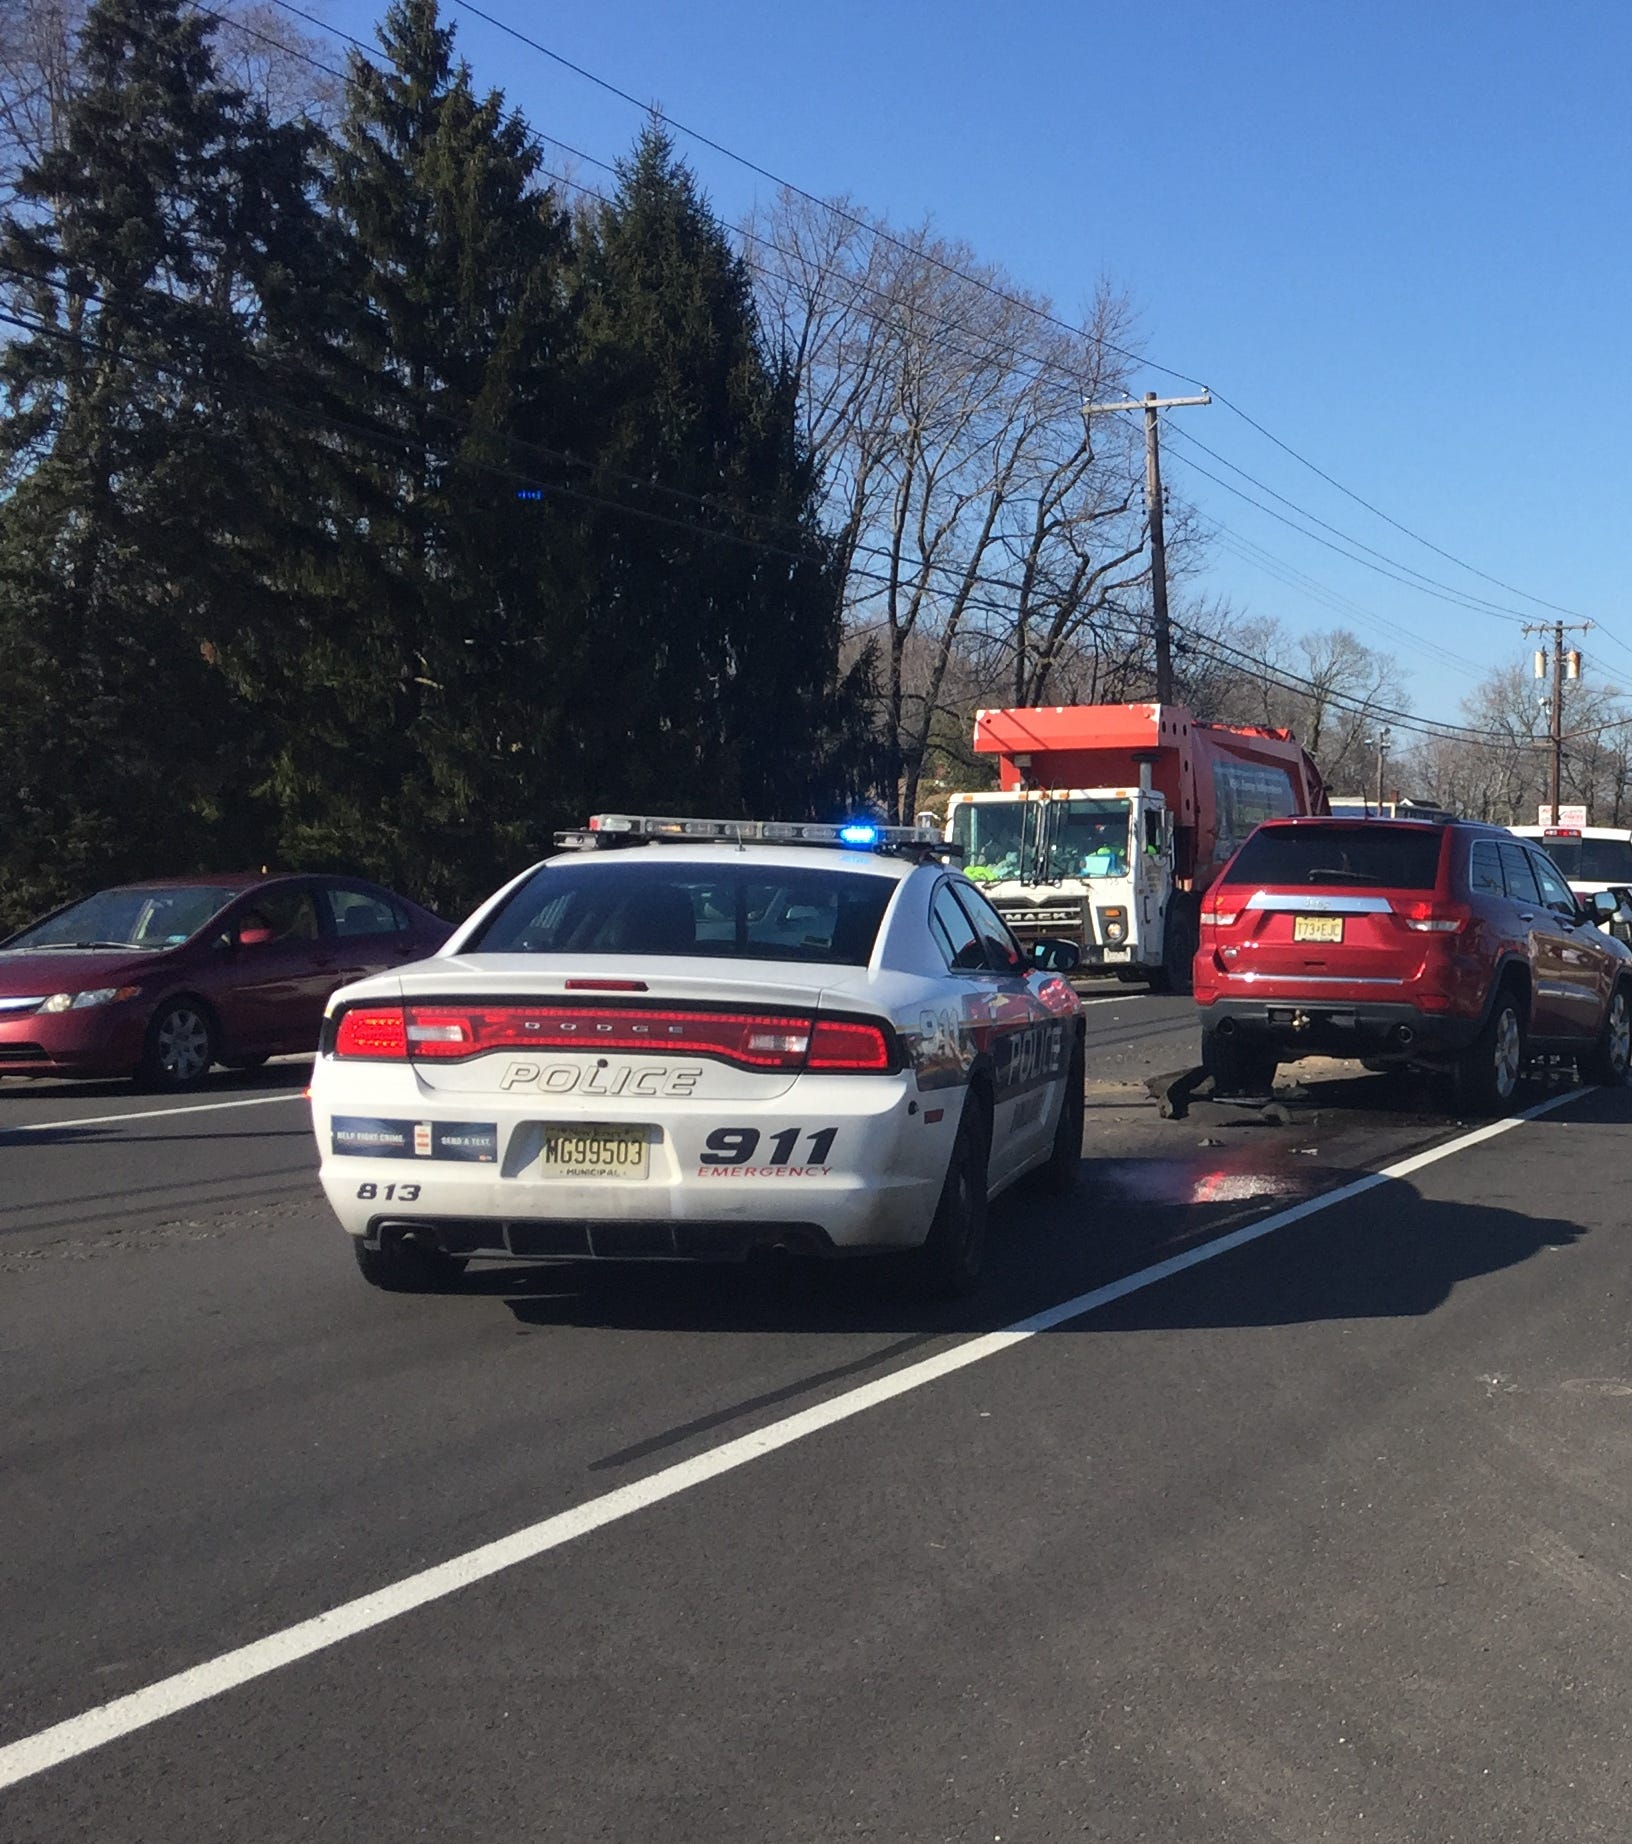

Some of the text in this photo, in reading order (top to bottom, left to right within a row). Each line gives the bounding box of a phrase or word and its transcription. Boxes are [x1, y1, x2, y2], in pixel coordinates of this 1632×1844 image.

[1005, 912, 1068, 921] MACK
[524, 1021, 684, 1034] DODGE
[1007, 1026, 1063, 1085] POLICE
[499, 1061, 703, 1096] POLICE
[545, 1138, 642, 1165] MG99503
[700, 1127, 839, 1165] 911
[566, 1167, 621, 1177] MUNICIPAL
[697, 1166, 833, 1177] EMERGENCY
[357, 1183, 421, 1201] 813
